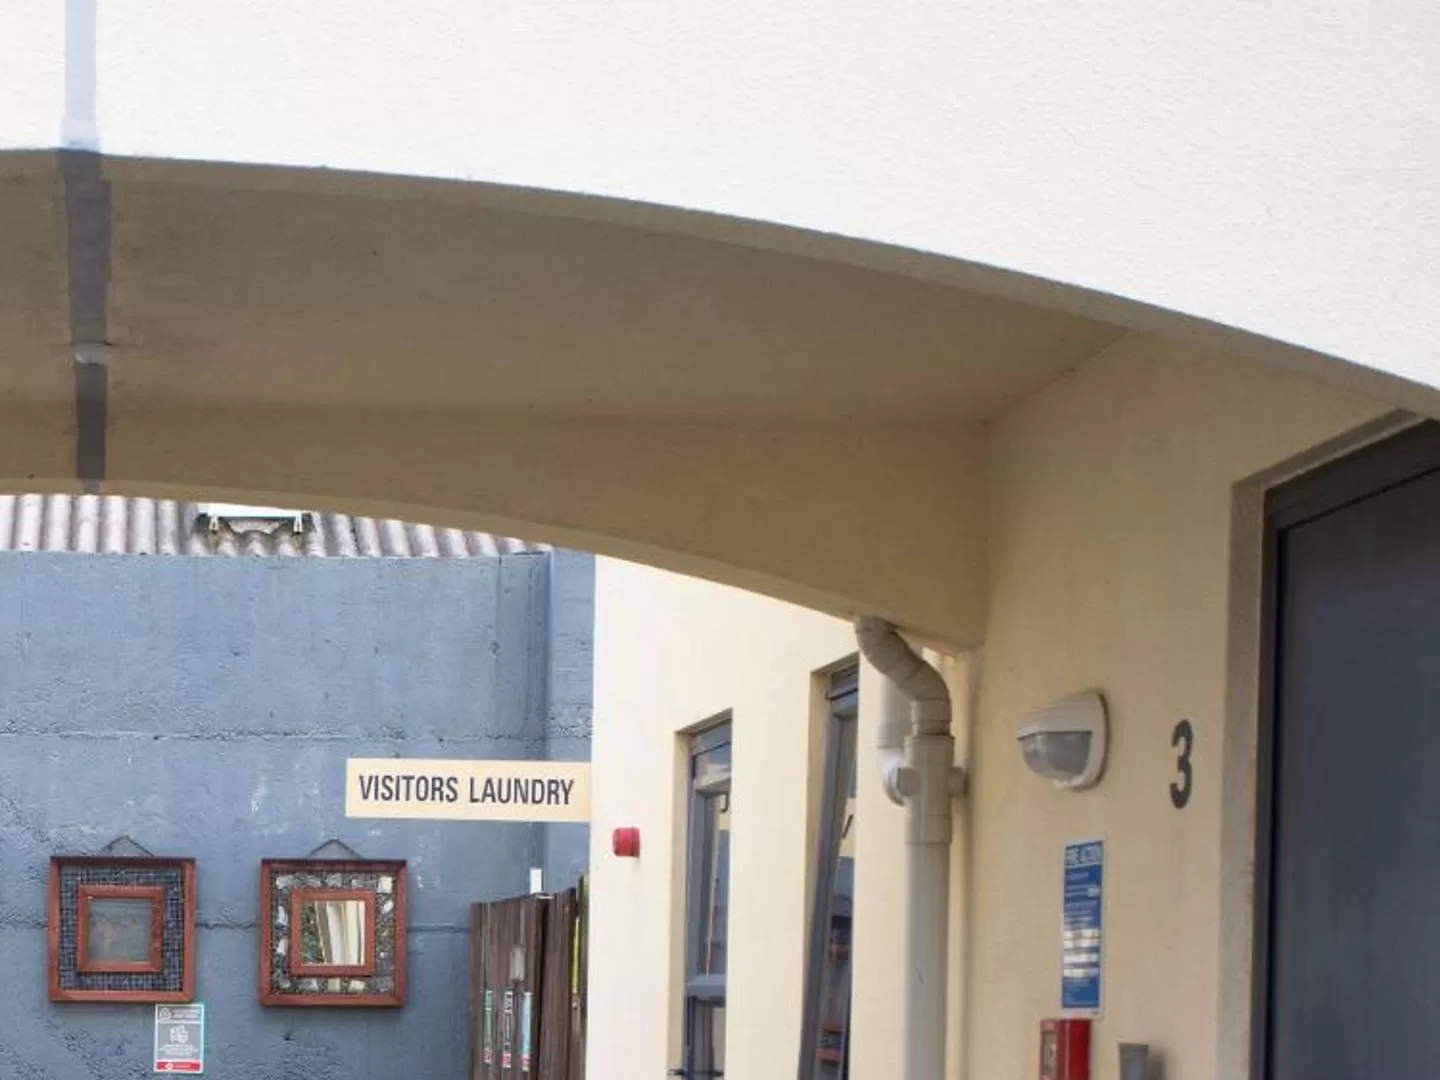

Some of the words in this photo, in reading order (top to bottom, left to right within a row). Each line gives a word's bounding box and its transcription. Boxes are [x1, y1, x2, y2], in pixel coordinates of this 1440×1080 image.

[359, 774, 459, 803] VISITORS
[469, 777, 574, 805] LAUNDRY
[1170, 719, 1193, 809] 3
